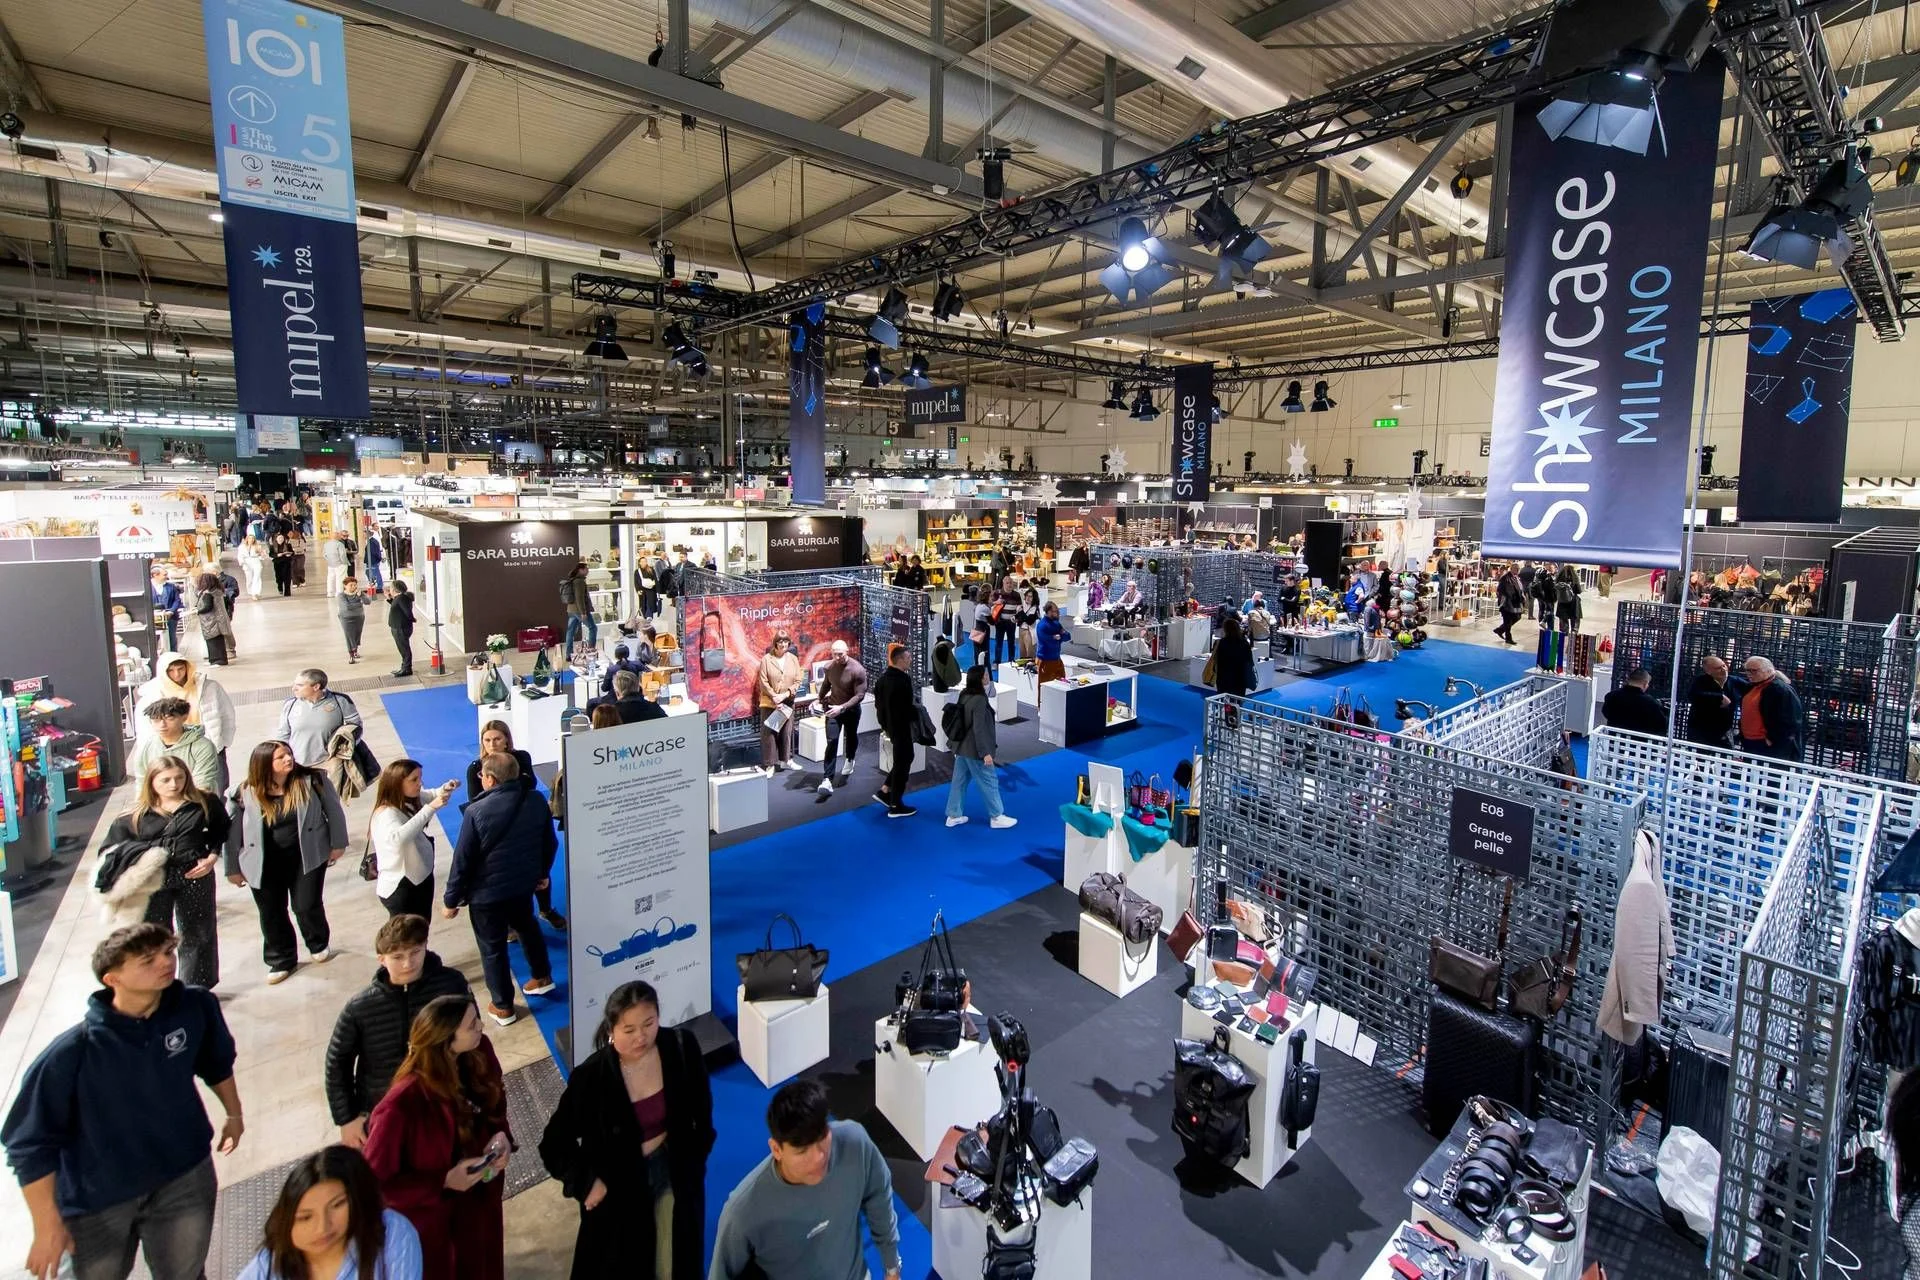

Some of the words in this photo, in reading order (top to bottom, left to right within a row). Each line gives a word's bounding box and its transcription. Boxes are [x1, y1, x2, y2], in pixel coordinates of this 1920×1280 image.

[250, 127, 273, 142] The
[301, 114, 341, 164] 5
[250, 138, 277, 153] Hub
[273, 175, 324, 192] MICAM
[274, 189, 298, 199] USCITA
[1617, 265, 1673, 444] MILANO
[888, 421, 900, 435] 5
[1197, 422, 1207, 470] MILANO
[1481, 445, 1491, 456] 5
[770, 538, 796, 547] SARA
[798, 536, 840, 546] BURGLAR
[467, 549, 506, 560] SARA
[510, 546, 575, 559] BURGLAR
[740, 605, 780, 621] Ripple
[783, 602, 794, 616] &
[796, 602, 814, 614] Co
[619, 756, 663, 773] MILANO
[1480, 802, 1504, 818] E08
[1469, 822, 1513, 844] Grande
[1474, 839, 1504, 855] pelle
